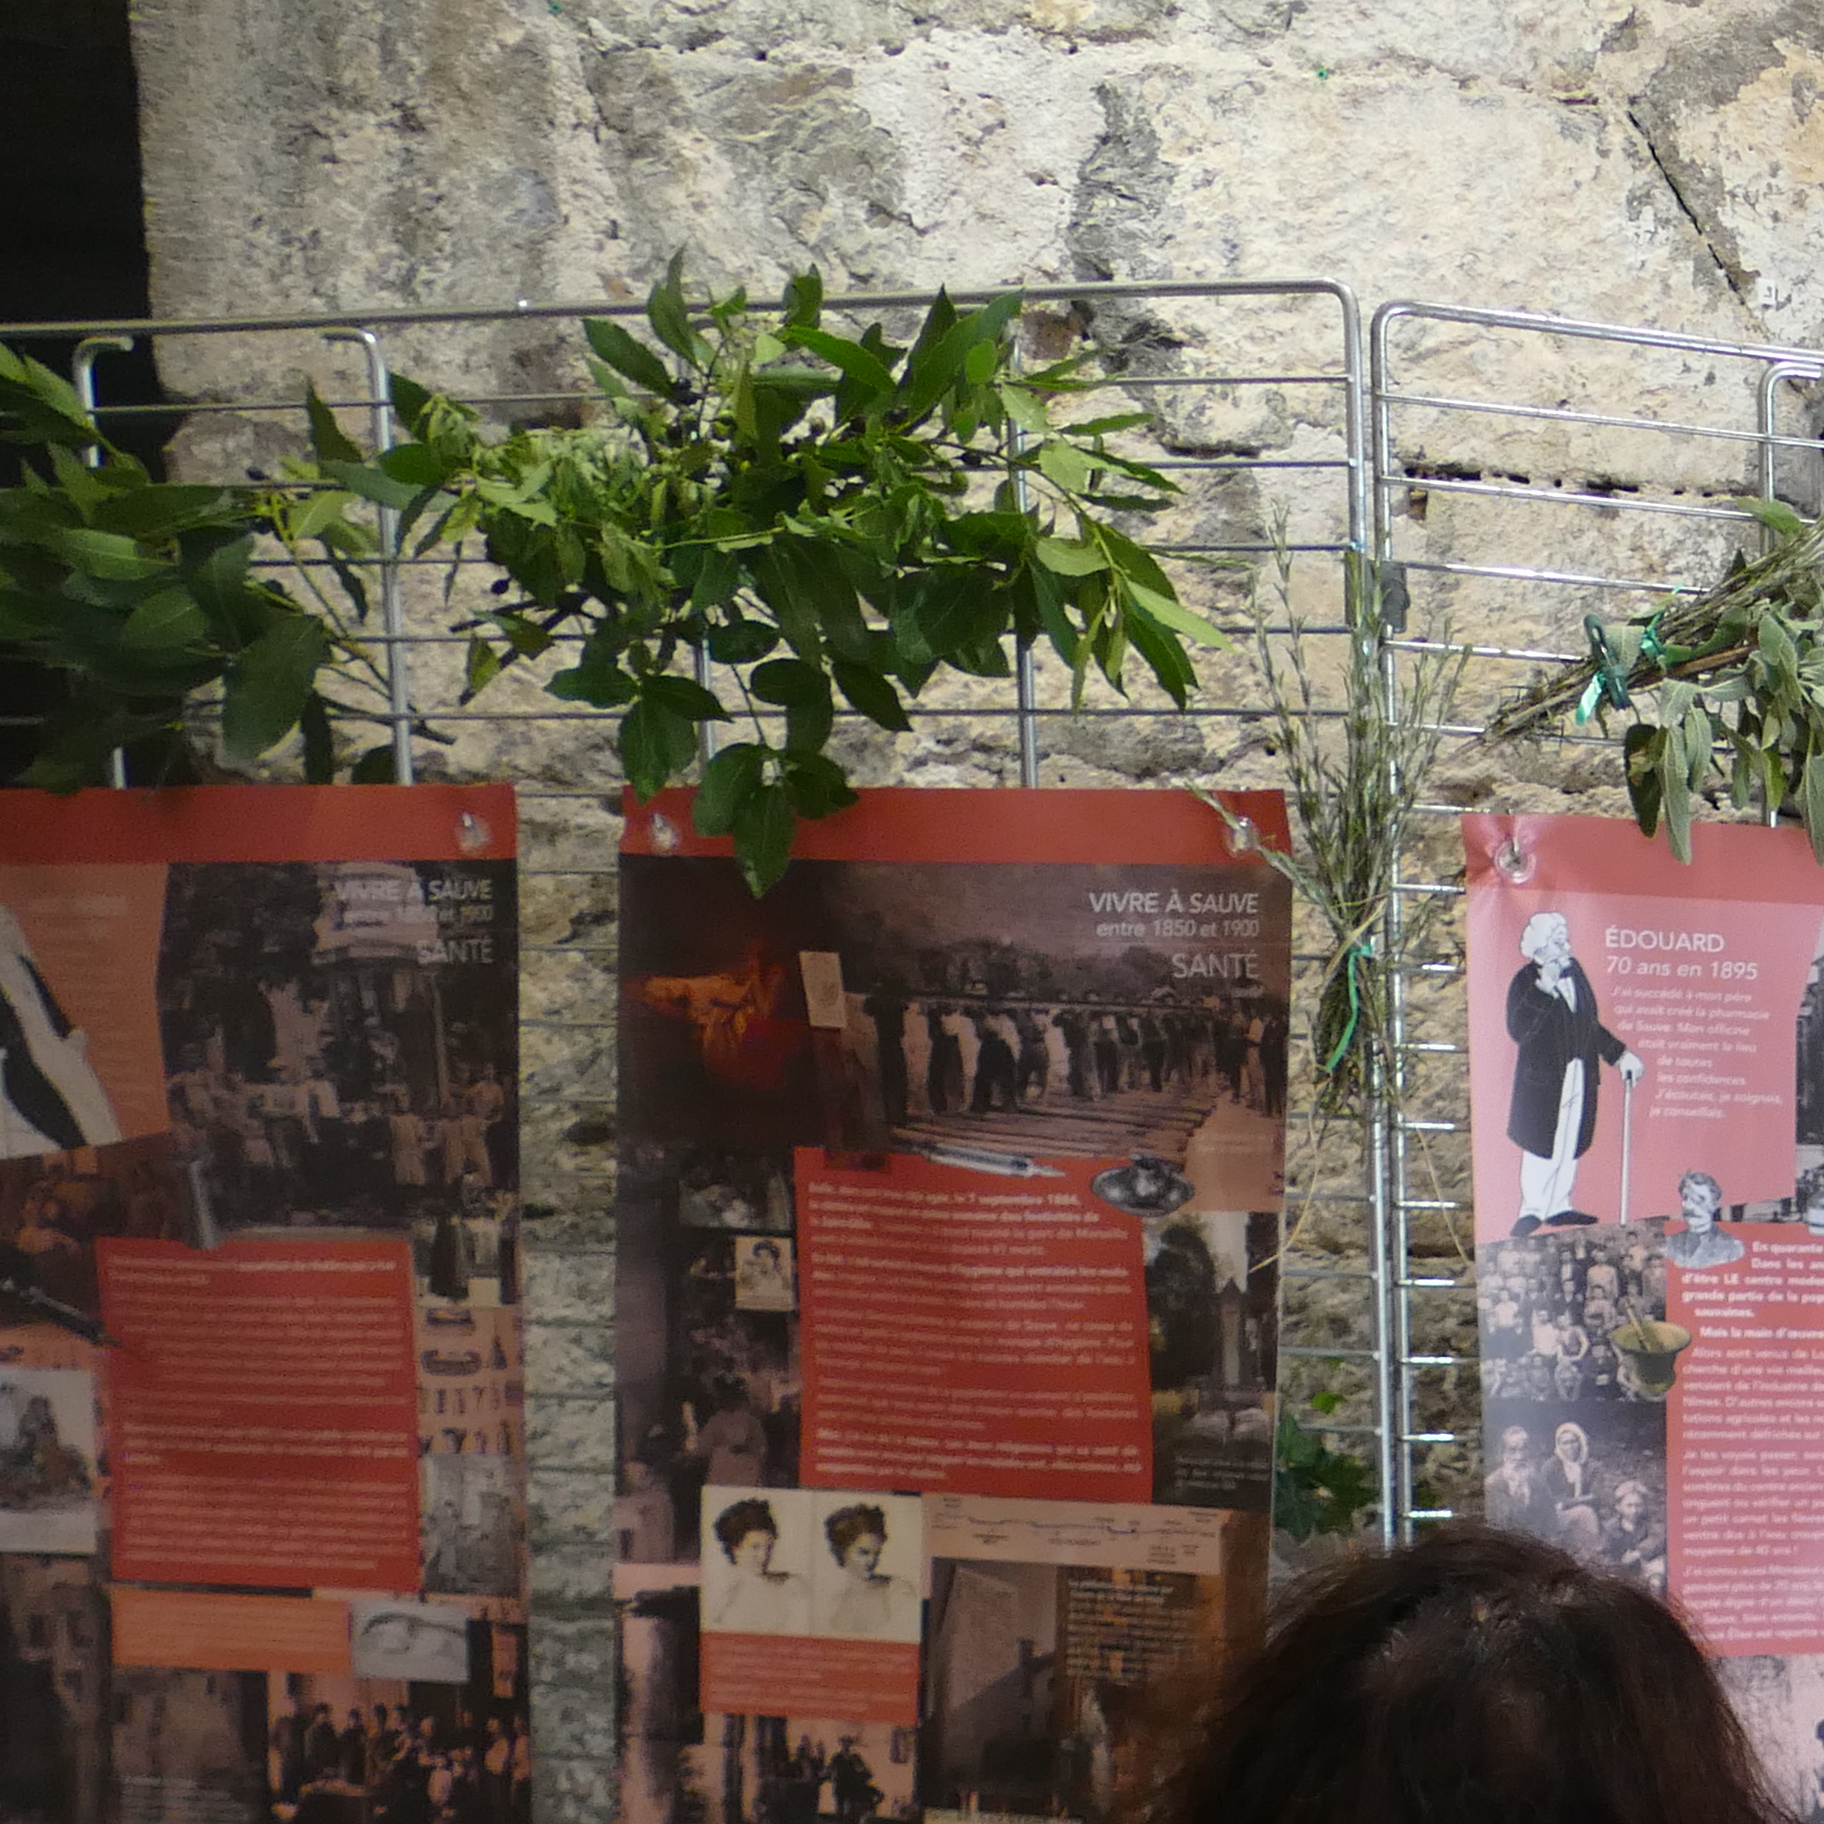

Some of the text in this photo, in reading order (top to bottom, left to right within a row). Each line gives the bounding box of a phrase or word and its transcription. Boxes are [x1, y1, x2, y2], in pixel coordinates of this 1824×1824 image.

[429, 879, 493, 900] SAUVE
[1089, 888, 1259, 914] VIVRE À SAUVE
[1096, 919, 1260, 937] entre 1850 et 1900
[1605, 925, 1725, 952] ÉDOUARD
[1172, 949, 1259, 979] SANTÉ
[1606, 955, 1758, 981] 70 ans en 1895
